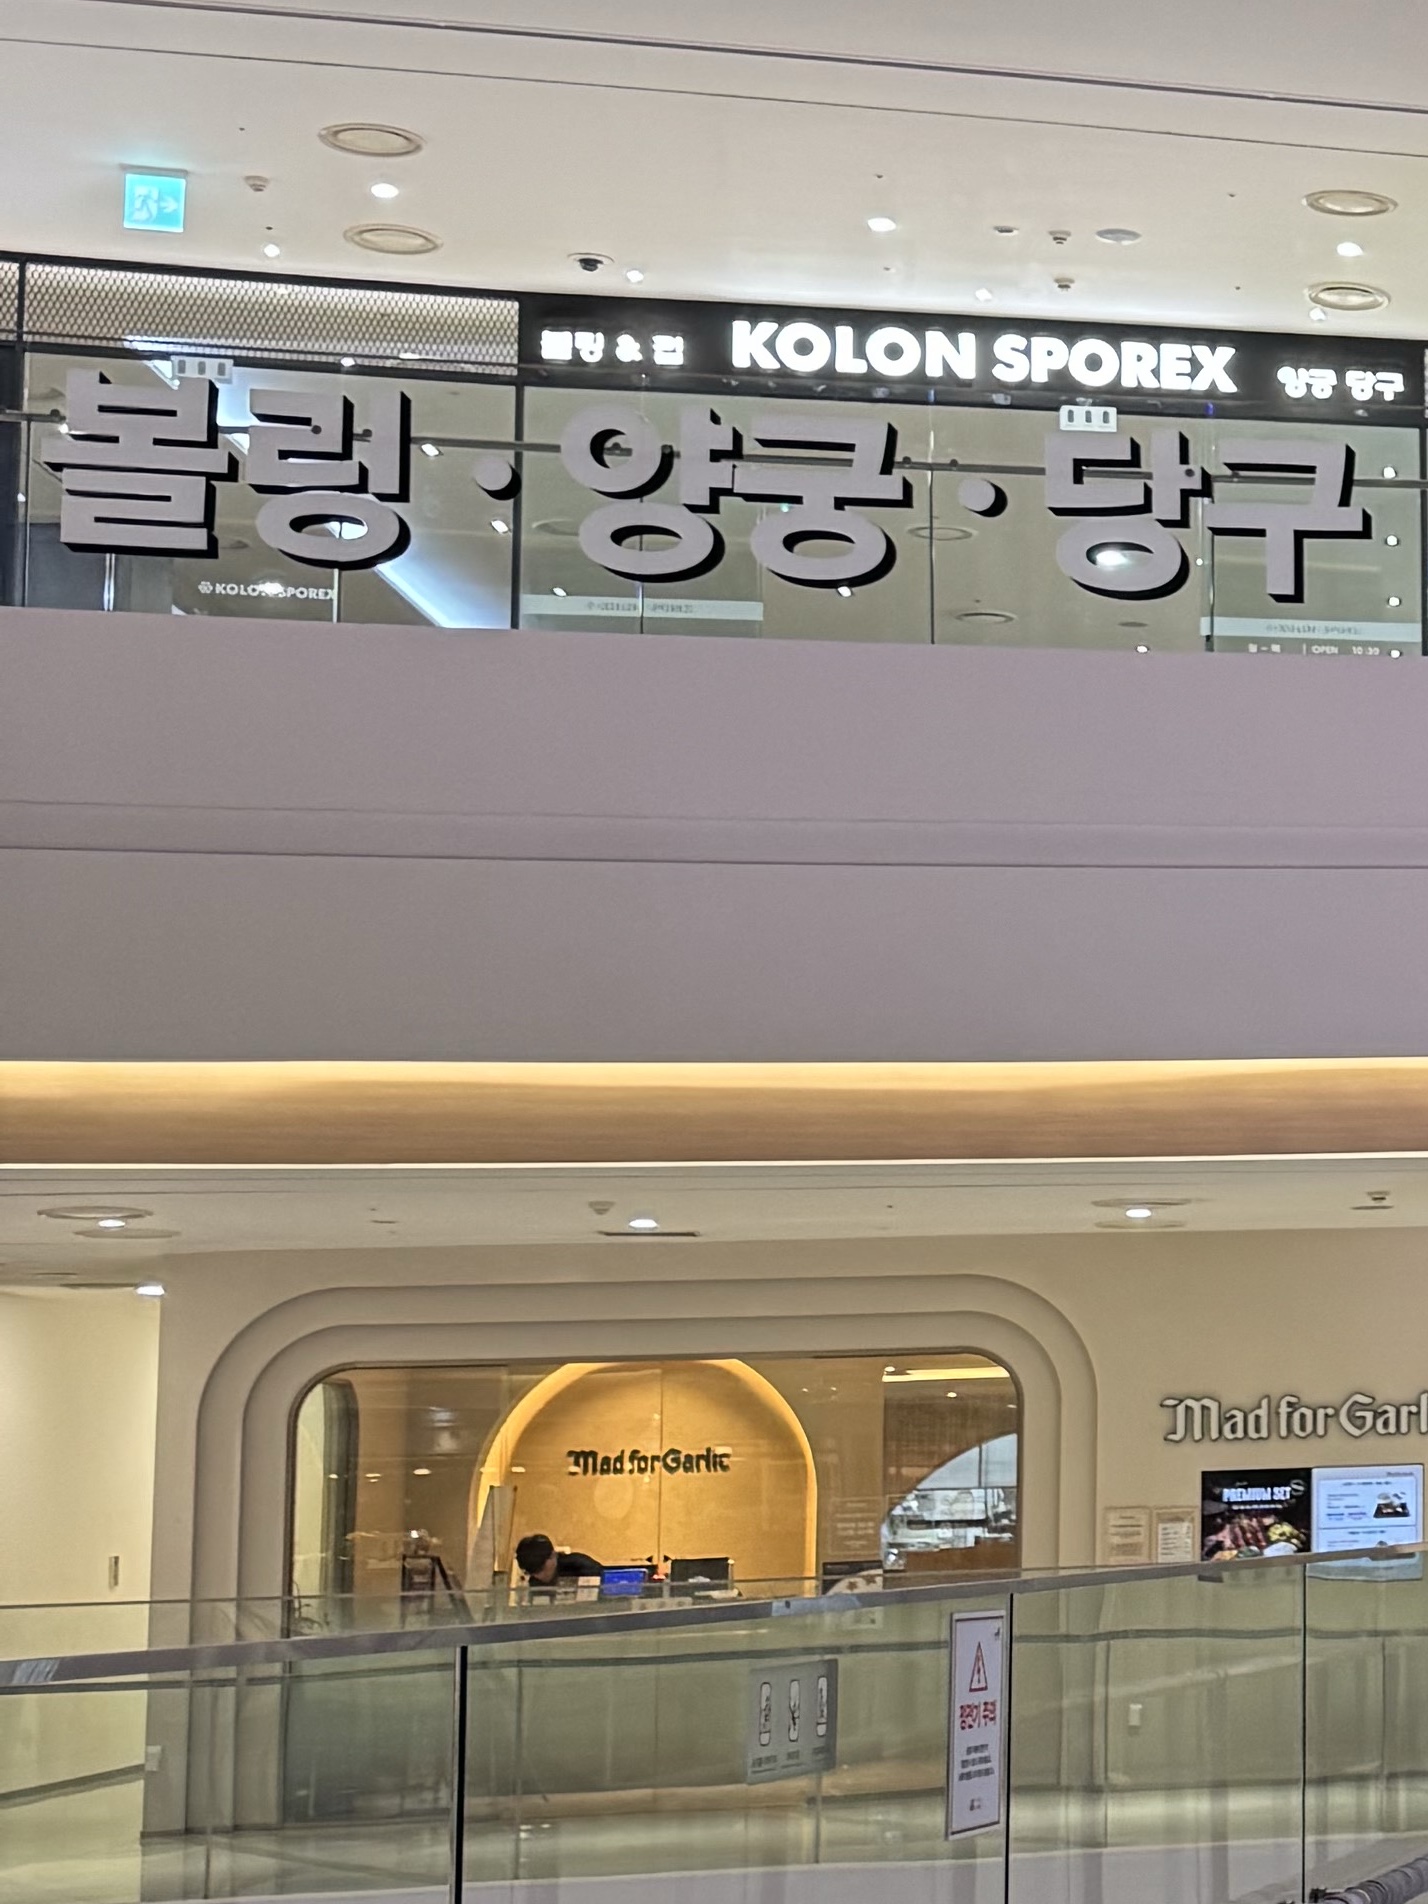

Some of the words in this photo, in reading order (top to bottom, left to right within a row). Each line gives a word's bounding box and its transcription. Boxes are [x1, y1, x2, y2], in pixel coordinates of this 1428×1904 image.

[731, 320, 976, 381] KOLON
[992, 334, 1237, 393] SPOREX
[42, 370, 411, 571] 볼링
[560, 405, 911, 589] 양궁
[1045, 430, 1371, 603] 당구
[215, 583, 267, 597] KOLO
[1160, 1394, 1271, 1443] Mad
[1278, 1394, 1335, 1438] for
[567, 1449, 625, 1476] Mad
[628, 1448, 661, 1475] for
[661, 1446, 732, 1475] Garlic
[1273, 1485, 1293, 1500] SET
